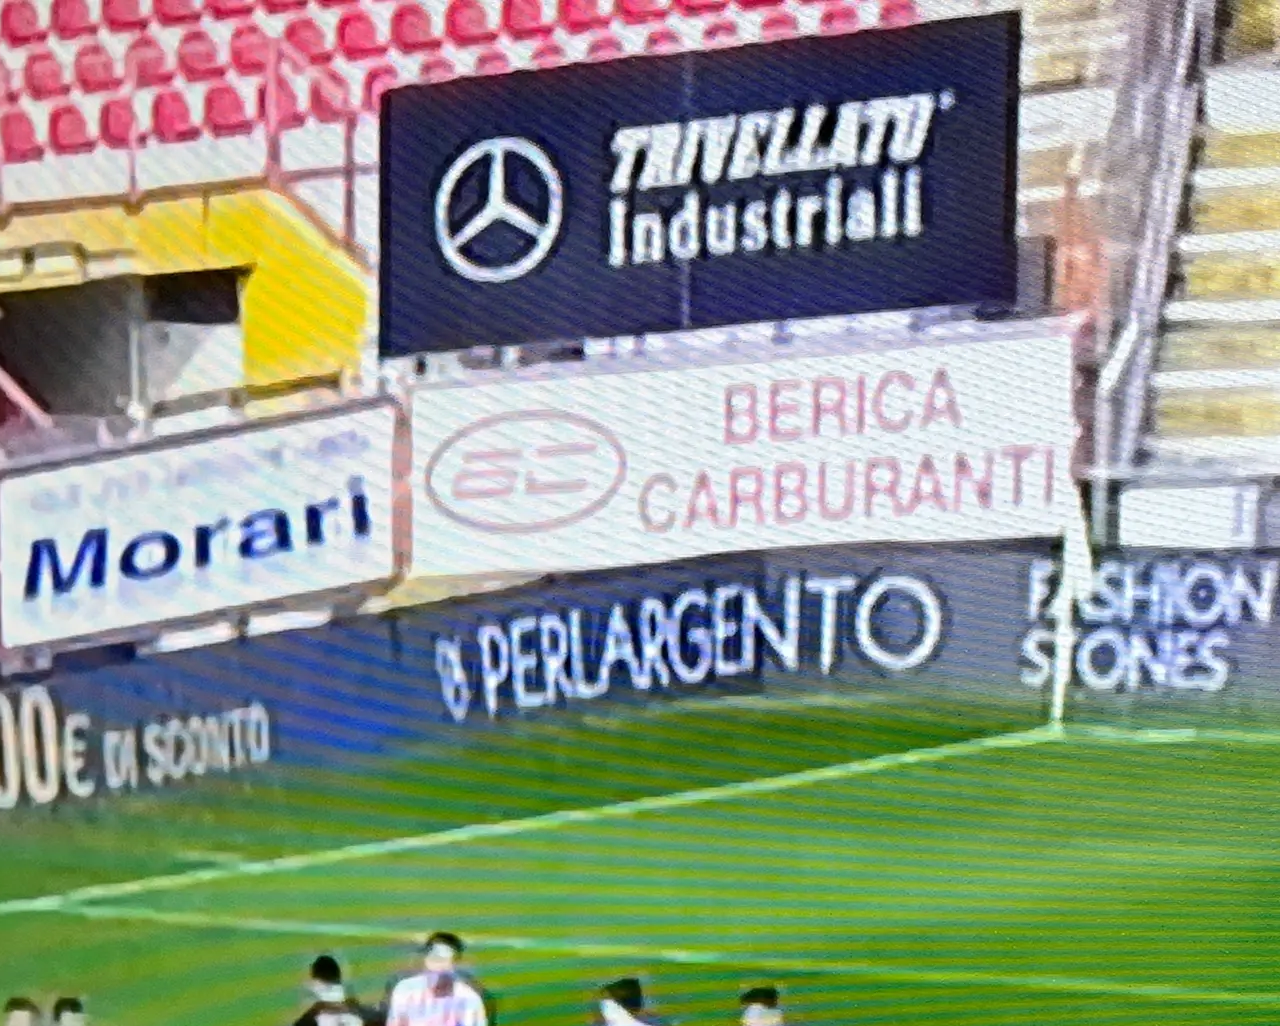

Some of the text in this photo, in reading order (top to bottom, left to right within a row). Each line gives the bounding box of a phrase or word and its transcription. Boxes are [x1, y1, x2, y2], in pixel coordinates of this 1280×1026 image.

[609, 92, 937, 195] TRIVELLATO
[607, 165, 924, 268] Industriali
[722, 367, 964, 447] BERICA
[637, 444, 1057, 534] CARBURANTI
[22, 474, 374, 602] Morari
[476, 573, 943, 720] PERLARGENTO
[1019, 626, 1231, 693] SONES
[101, 729, 139, 790] DI
[142, 699, 272, 786] SCONTO
